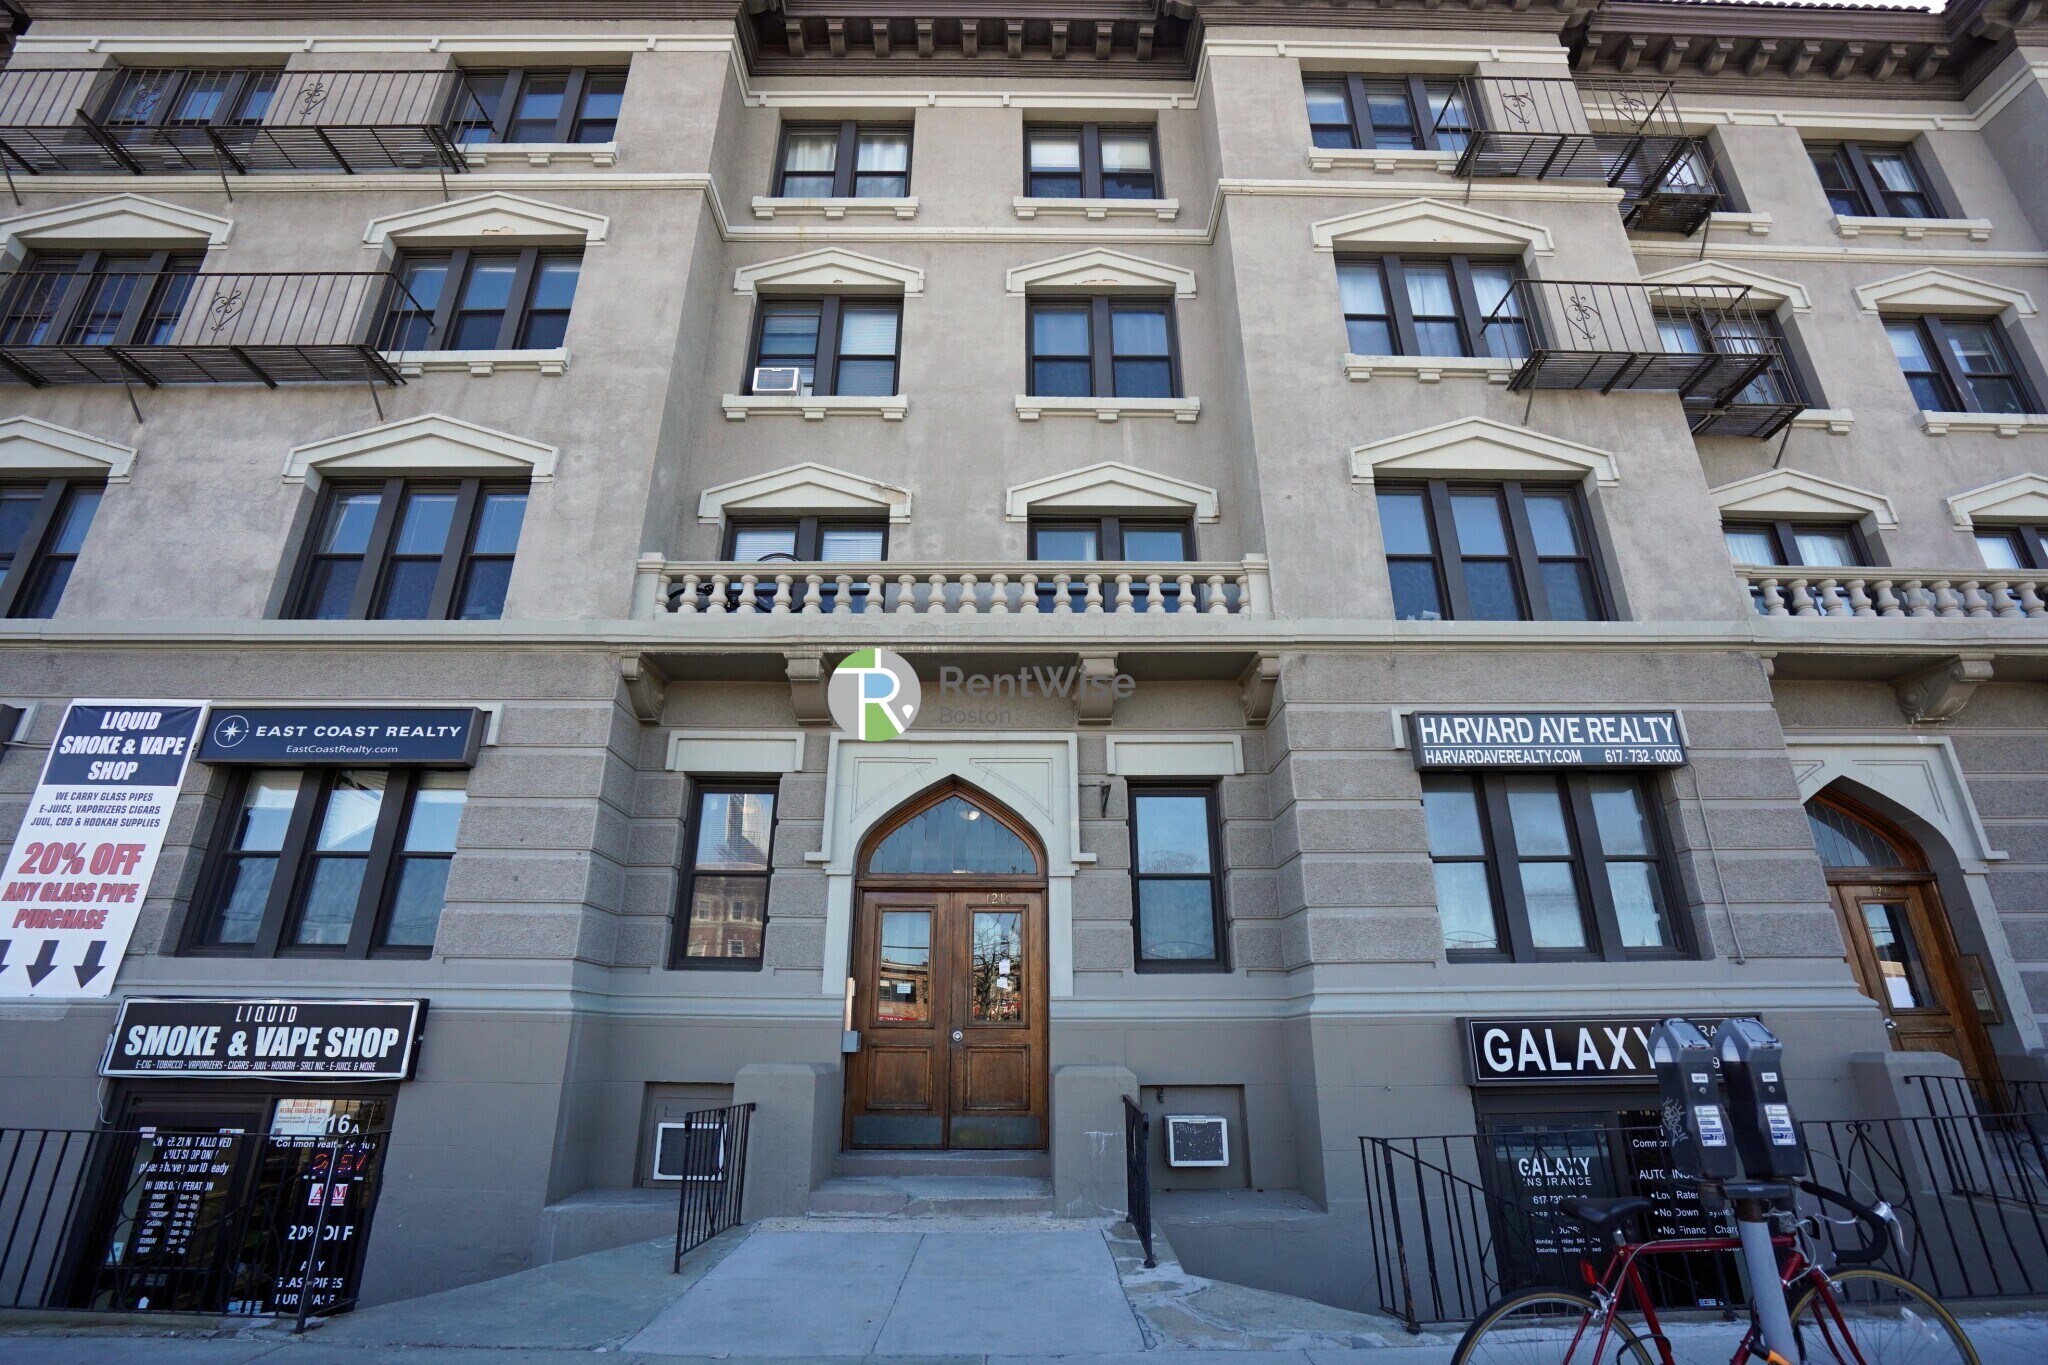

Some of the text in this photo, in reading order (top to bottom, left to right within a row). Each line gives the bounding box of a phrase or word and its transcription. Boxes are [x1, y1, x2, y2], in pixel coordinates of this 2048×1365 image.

[100, 711, 162, 731] LIQUID
[255, 726, 462, 738] EAST COAST REALTY
[1419, 717, 1674, 744] HARVARD AVE REALTY
[59, 735, 187, 755] SMOKE & VAPE
[286, 745, 398, 755] EastCoastRealty.com
[1424, 749, 1682, 764] HARVARDAVEREALTY.COM 617-732-0000
[87, 761, 138, 780] SHOP
[55, 792, 153, 802] WE CARRY GLASS PIPES
[39, 804, 161, 815] E-JUICE, VAPORIZERS CIGARS
[30, 817, 160, 828] JUUL, CBD & HOOKAH SUPPLIES
[18, 842, 146, 875] 20% OFF
[2, 882, 139, 903] ANY GLASS PIPE
[12, 909, 109, 930] PURCHASE
[235, 1006, 297, 1023] LIQUID
[124, 1025, 399, 1058] SMOKE & VAPE SHOP
[136, 1060, 152, 1069] E-CIG
[156, 1060, 184, 1069] TOBACCO
[188, 1060, 223, 1070] VAPORIZERS
[227, 1060, 249, 1070] CIGARS
[252, 1061, 267, 1070] JUUL
[271, 1061, 296, 1070] HOOKAH
[300, 1061, 314, 1071] SALT
[315, 1061, 325, 1071] NIC
[329, 1061, 351, 1071] E-JUICE
[353, 1062, 358, 1071] &
[359, 1062, 376, 1071] MORE
[176, 1137, 185, 1147] 21
[185, 1137, 199, 1147] NT
[210, 1162, 230, 1175] eady
[1518, 1157, 1589, 1177] GALAXY
[178, 1181, 214, 1191] PERATON
[313, 1185, 348, 1198] AM
[1659, 1208, 1672, 1217] No
[1662, 1225, 1675, 1235] No
[1680, 1225, 1707, 1235] Financ
[300, 1260, 326, 1272] AY
